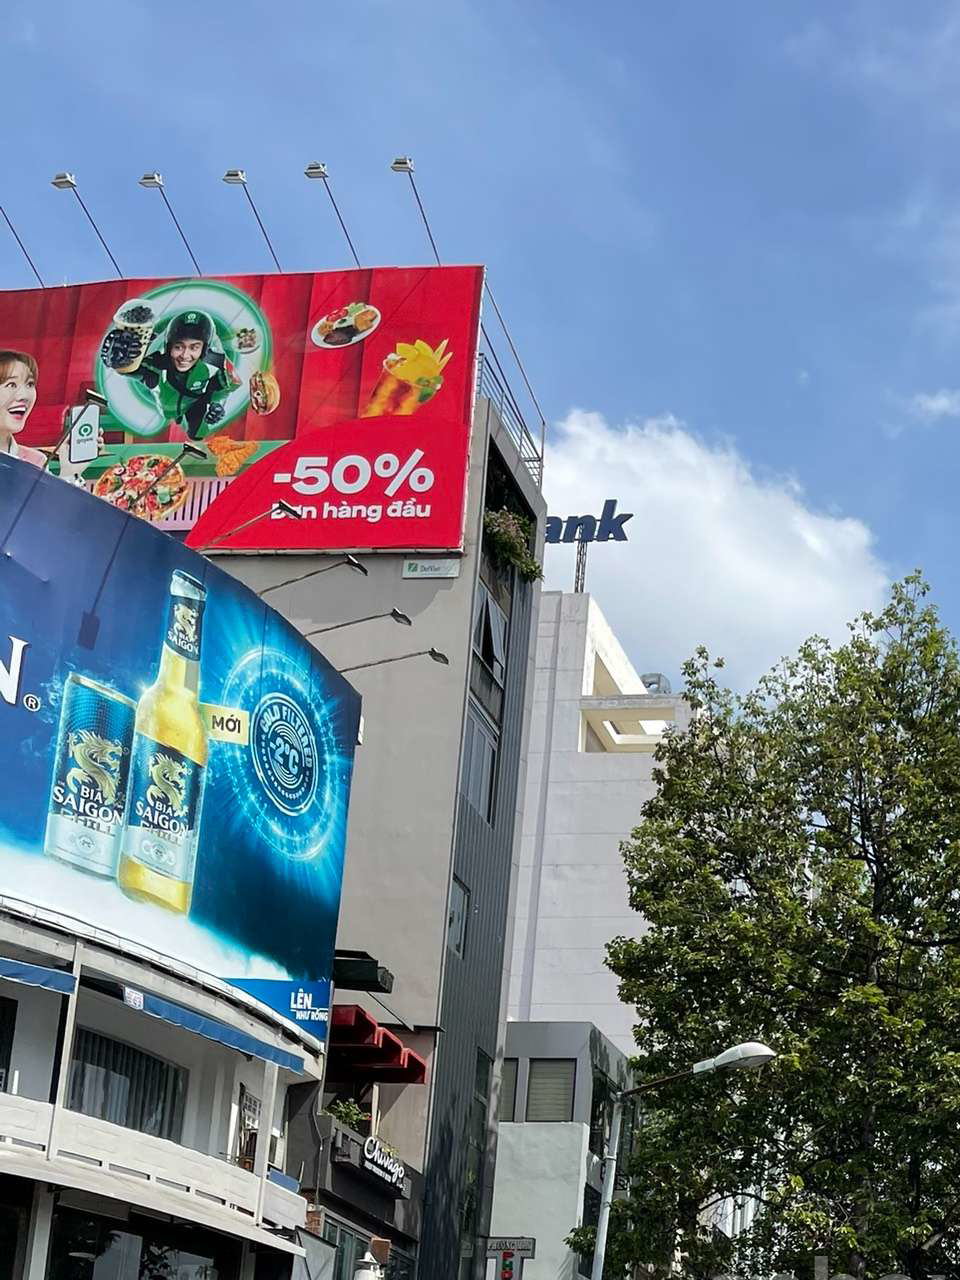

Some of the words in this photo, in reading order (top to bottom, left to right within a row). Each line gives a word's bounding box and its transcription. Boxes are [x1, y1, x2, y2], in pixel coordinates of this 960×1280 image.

[273, 448, 435, 497] -50%
[322, 501, 383, 523] hàng
[386, 497, 432, 518] đầu
[211, 715, 242, 734] MỚI
[52, 785, 124, 826] SAIGON
[79, 785, 104, 804] BIA
[135, 800, 190, 835] SAIGON
[155, 801, 174, 817] BIA
[290, 987, 313, 1009] LÊN
